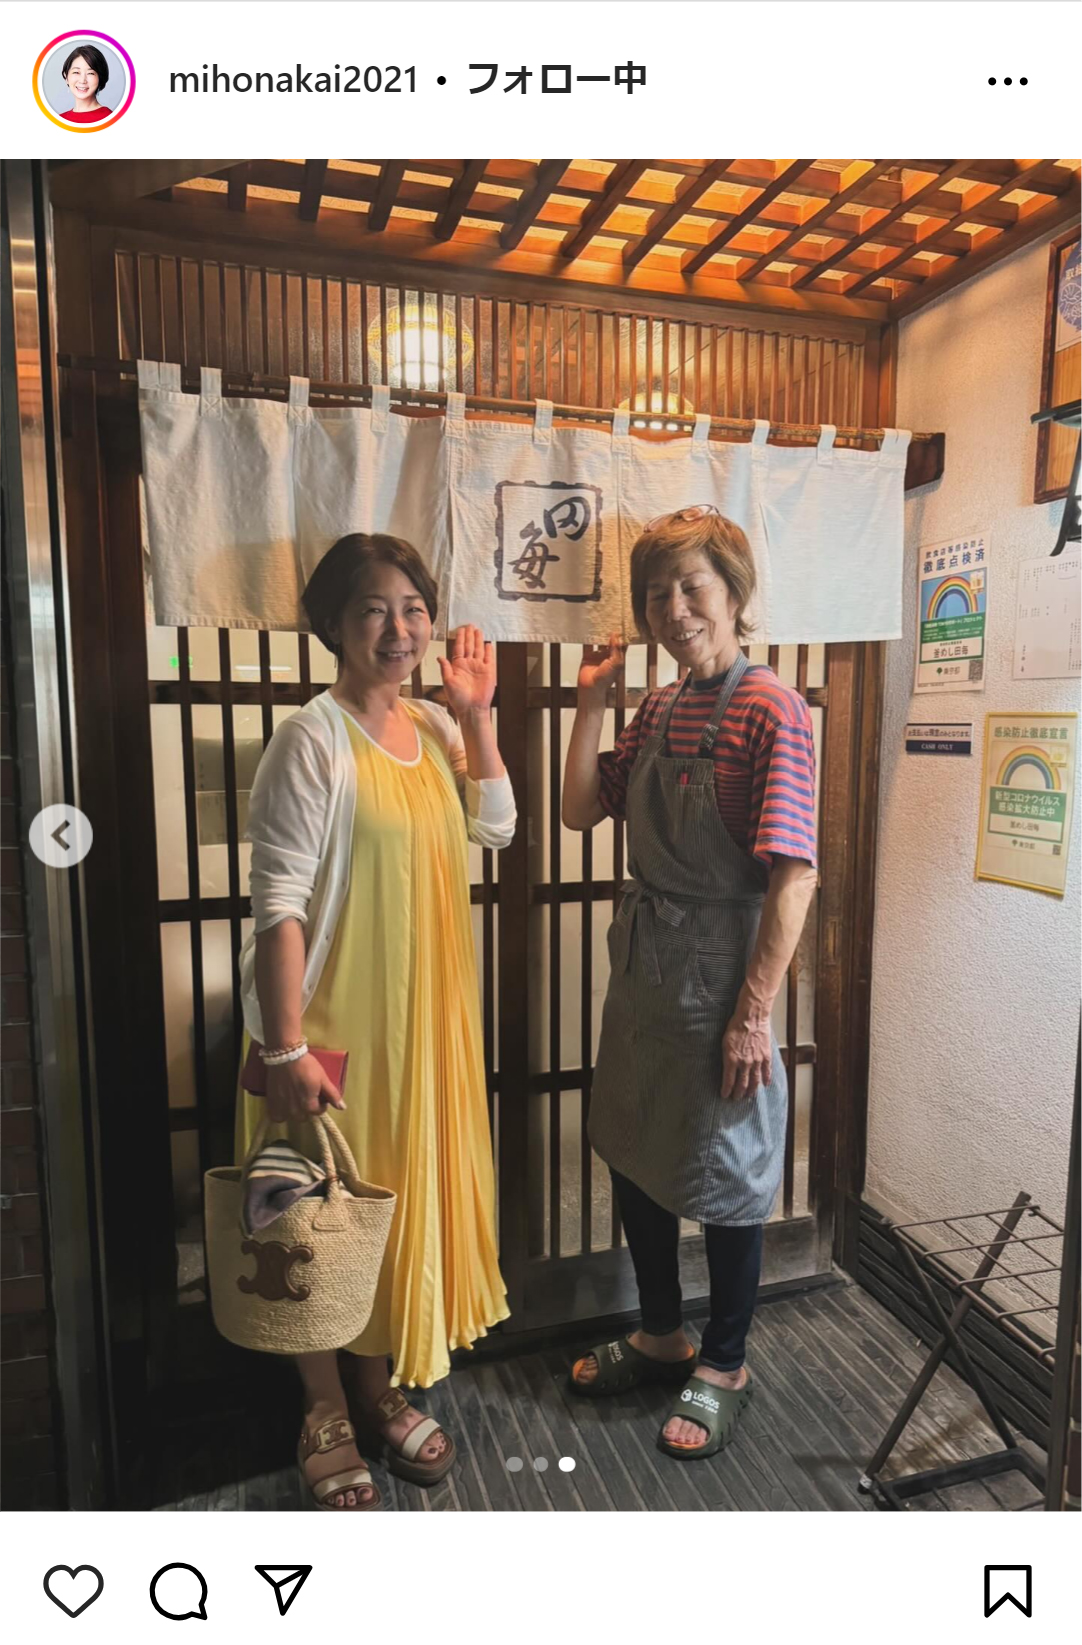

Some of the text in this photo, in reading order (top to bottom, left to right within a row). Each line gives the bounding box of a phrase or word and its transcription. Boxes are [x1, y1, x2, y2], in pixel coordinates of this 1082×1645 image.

[923, 549, 985, 574] 徹底点検済
[933, 646, 968, 658] 釜めし田毎
[994, 726, 1068, 740] 感染防止徹底宣言
[995, 790, 1060, 807] 新型コロナウイルス
[998, 801, 1056, 818] 感染拡大防止中
[693, 1391, 720, 1409] LOGOS
